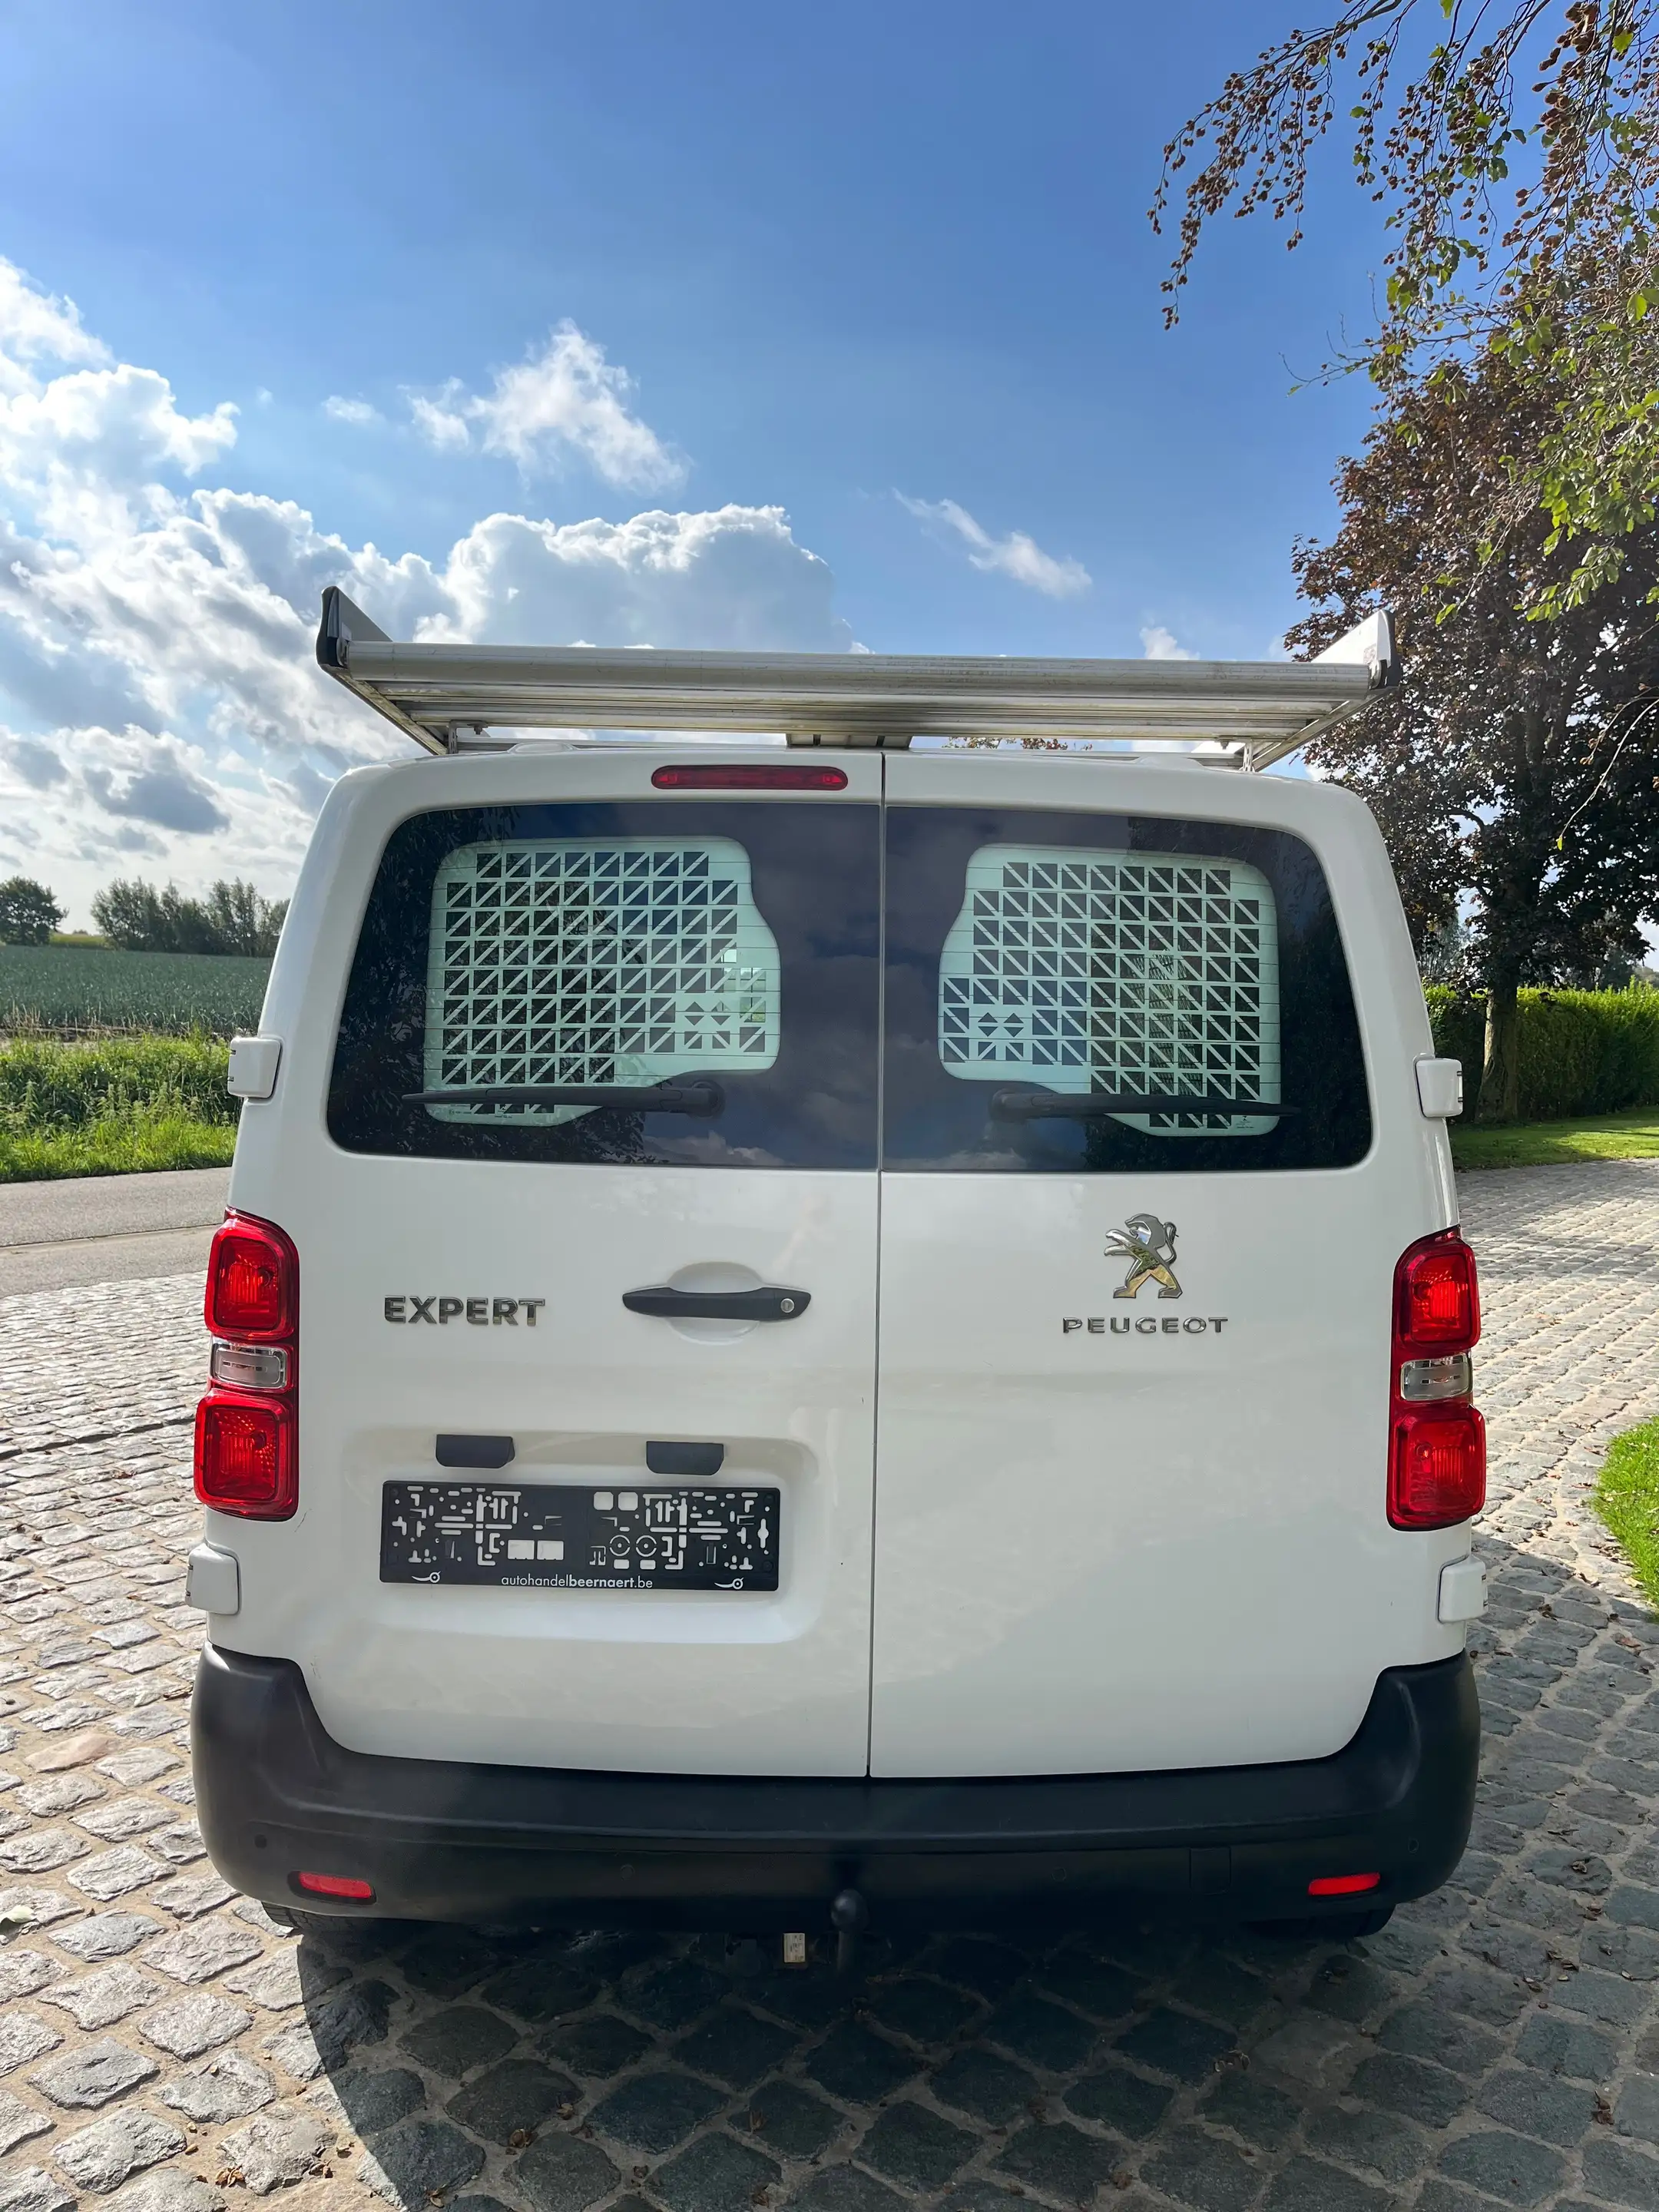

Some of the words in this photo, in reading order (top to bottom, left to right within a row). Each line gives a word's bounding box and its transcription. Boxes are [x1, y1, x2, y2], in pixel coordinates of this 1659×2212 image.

[385, 1295, 546, 1326] EXPERT
[1062, 1316, 1228, 1333] PEUGEOT
[501, 1573, 654, 1588] autohandelbeernaert.be
